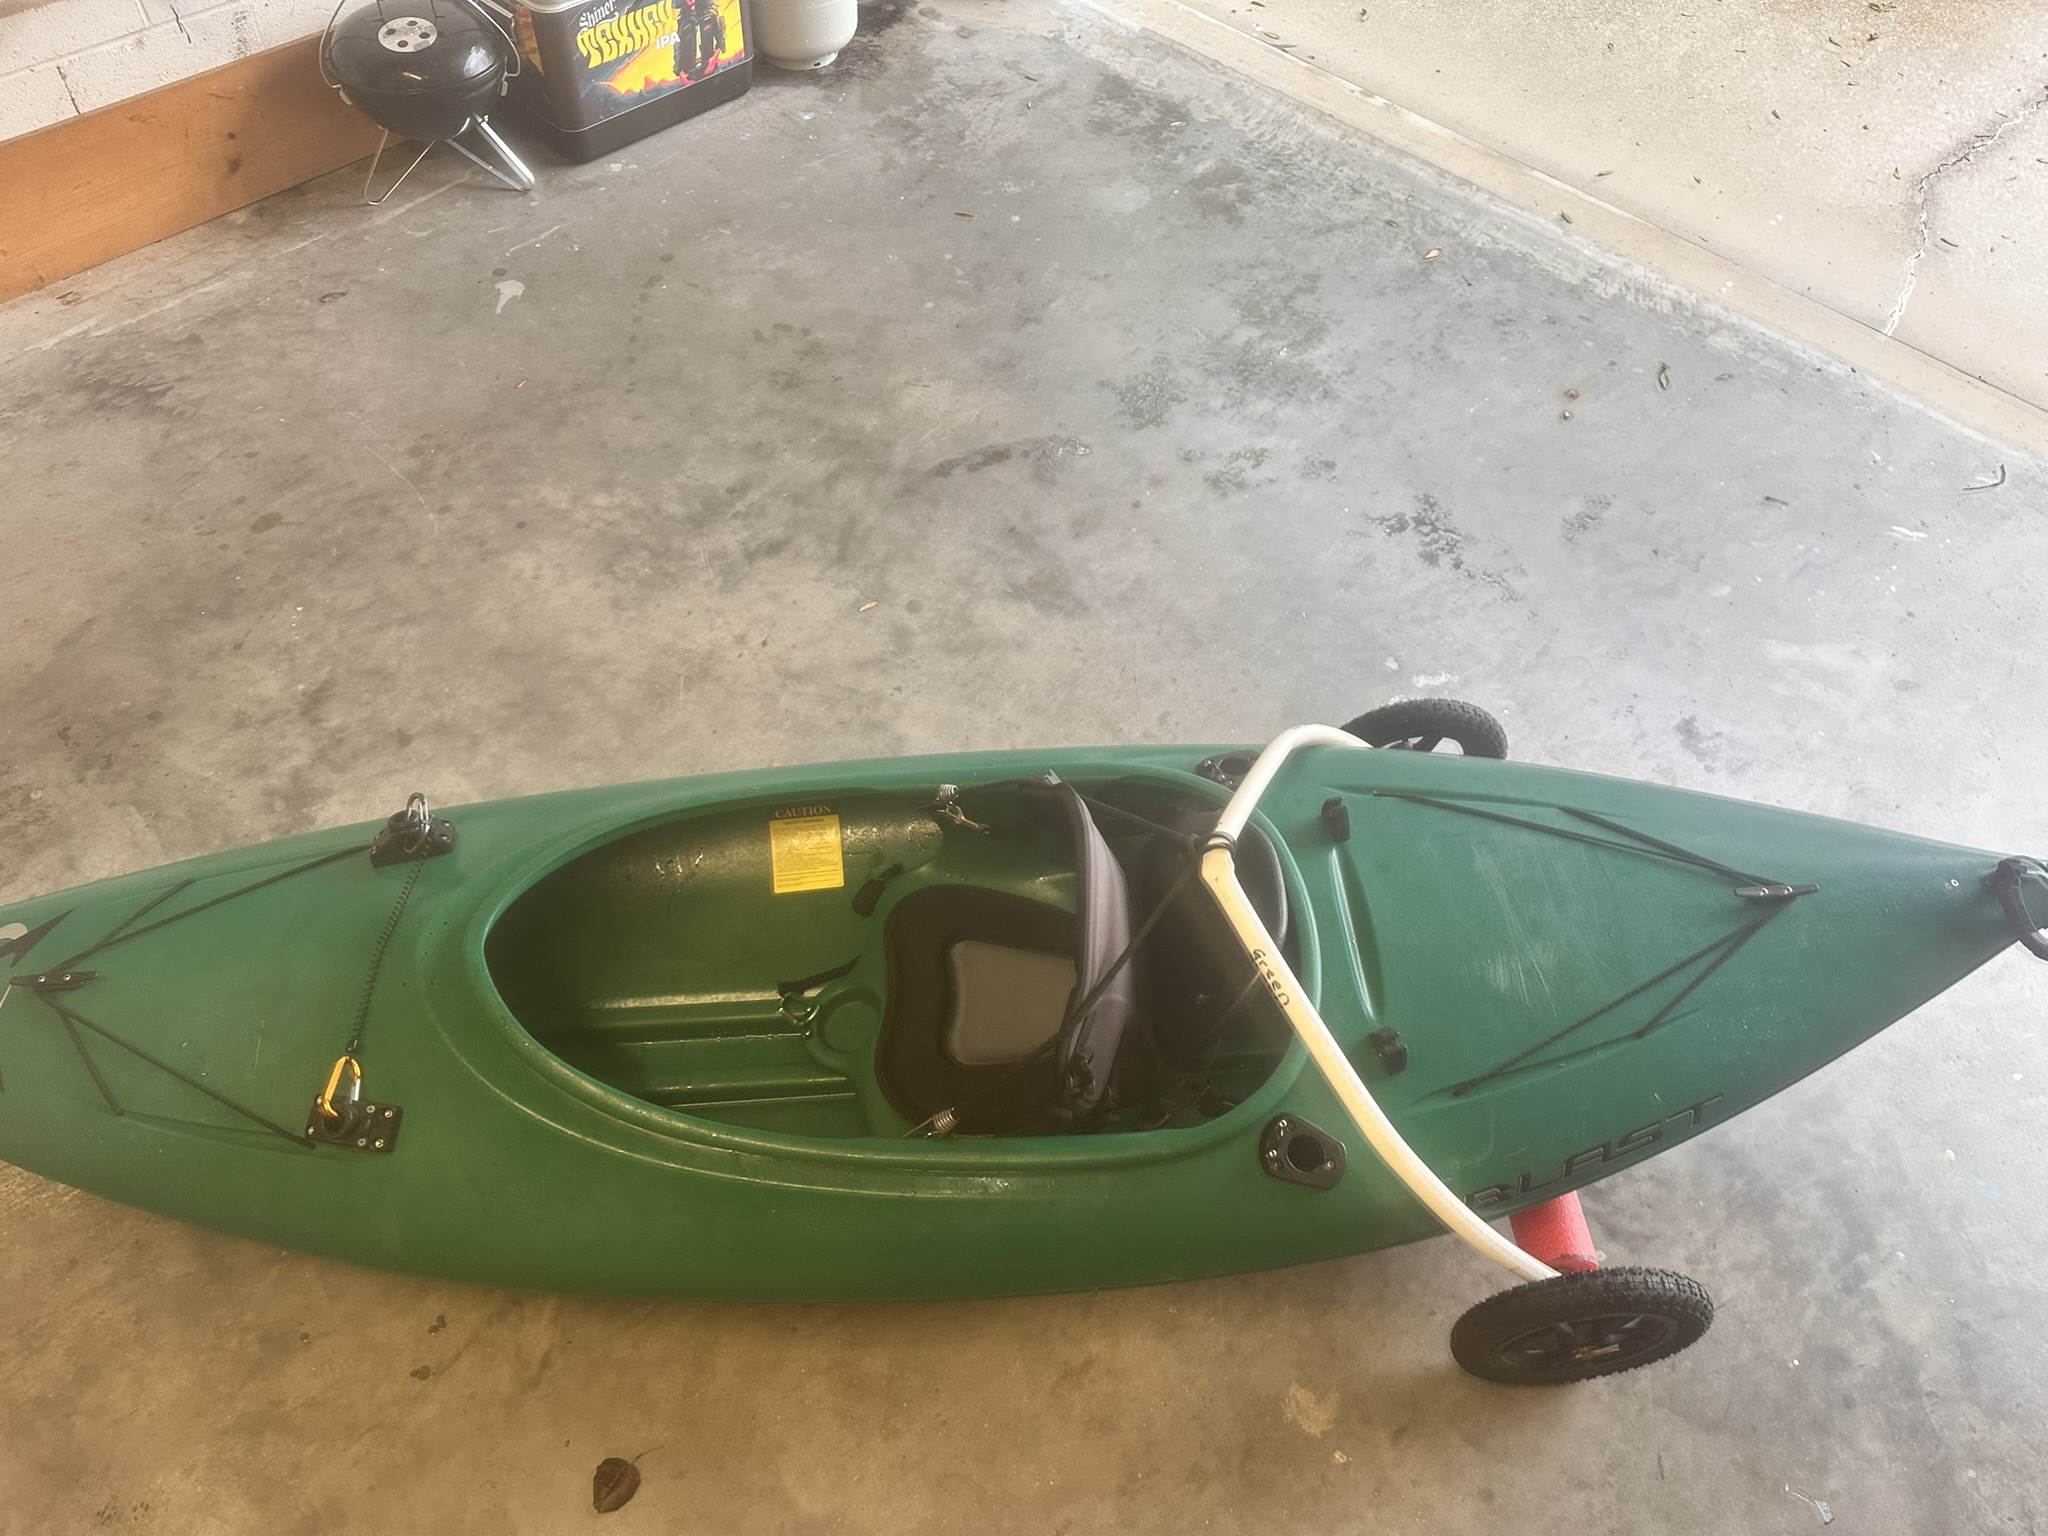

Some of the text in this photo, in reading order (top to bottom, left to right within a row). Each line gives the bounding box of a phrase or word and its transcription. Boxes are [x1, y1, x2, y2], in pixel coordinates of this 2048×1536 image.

[655, 31, 681, 50] IPA
[775, 805, 832, 818] CAUTION
[1252, 948, 1290, 1006] Green
[1463, 1092, 1724, 1209] BLAST
